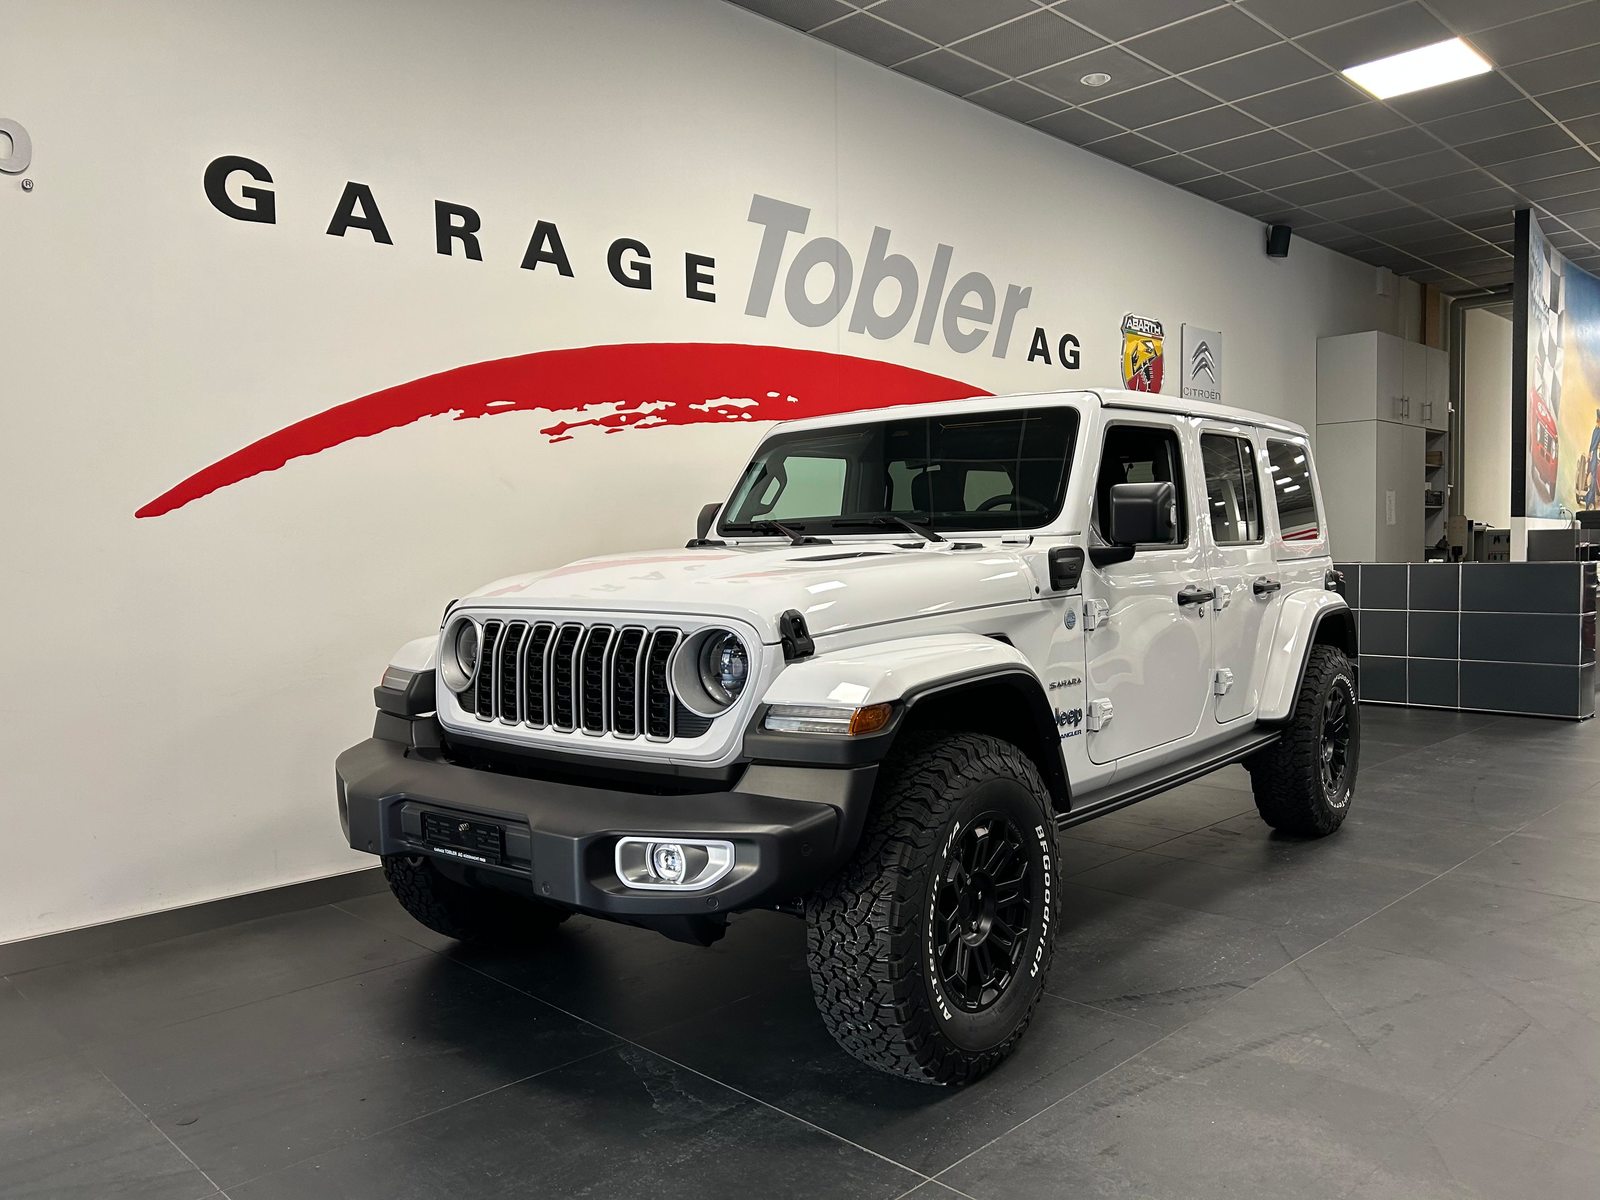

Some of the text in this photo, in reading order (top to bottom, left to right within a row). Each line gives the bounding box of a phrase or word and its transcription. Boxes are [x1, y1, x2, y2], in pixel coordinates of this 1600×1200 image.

[203, 155, 1081, 370] GARAGE Tobler AG
[1126, 318, 1161, 335] ABARTH
[1049, 678, 1082, 690] SAHARA
[1055, 707, 1082, 728] Jeep
[1060, 729, 1082, 739] ANGLER
[1030, 825, 1051, 978] BFGoodrich
